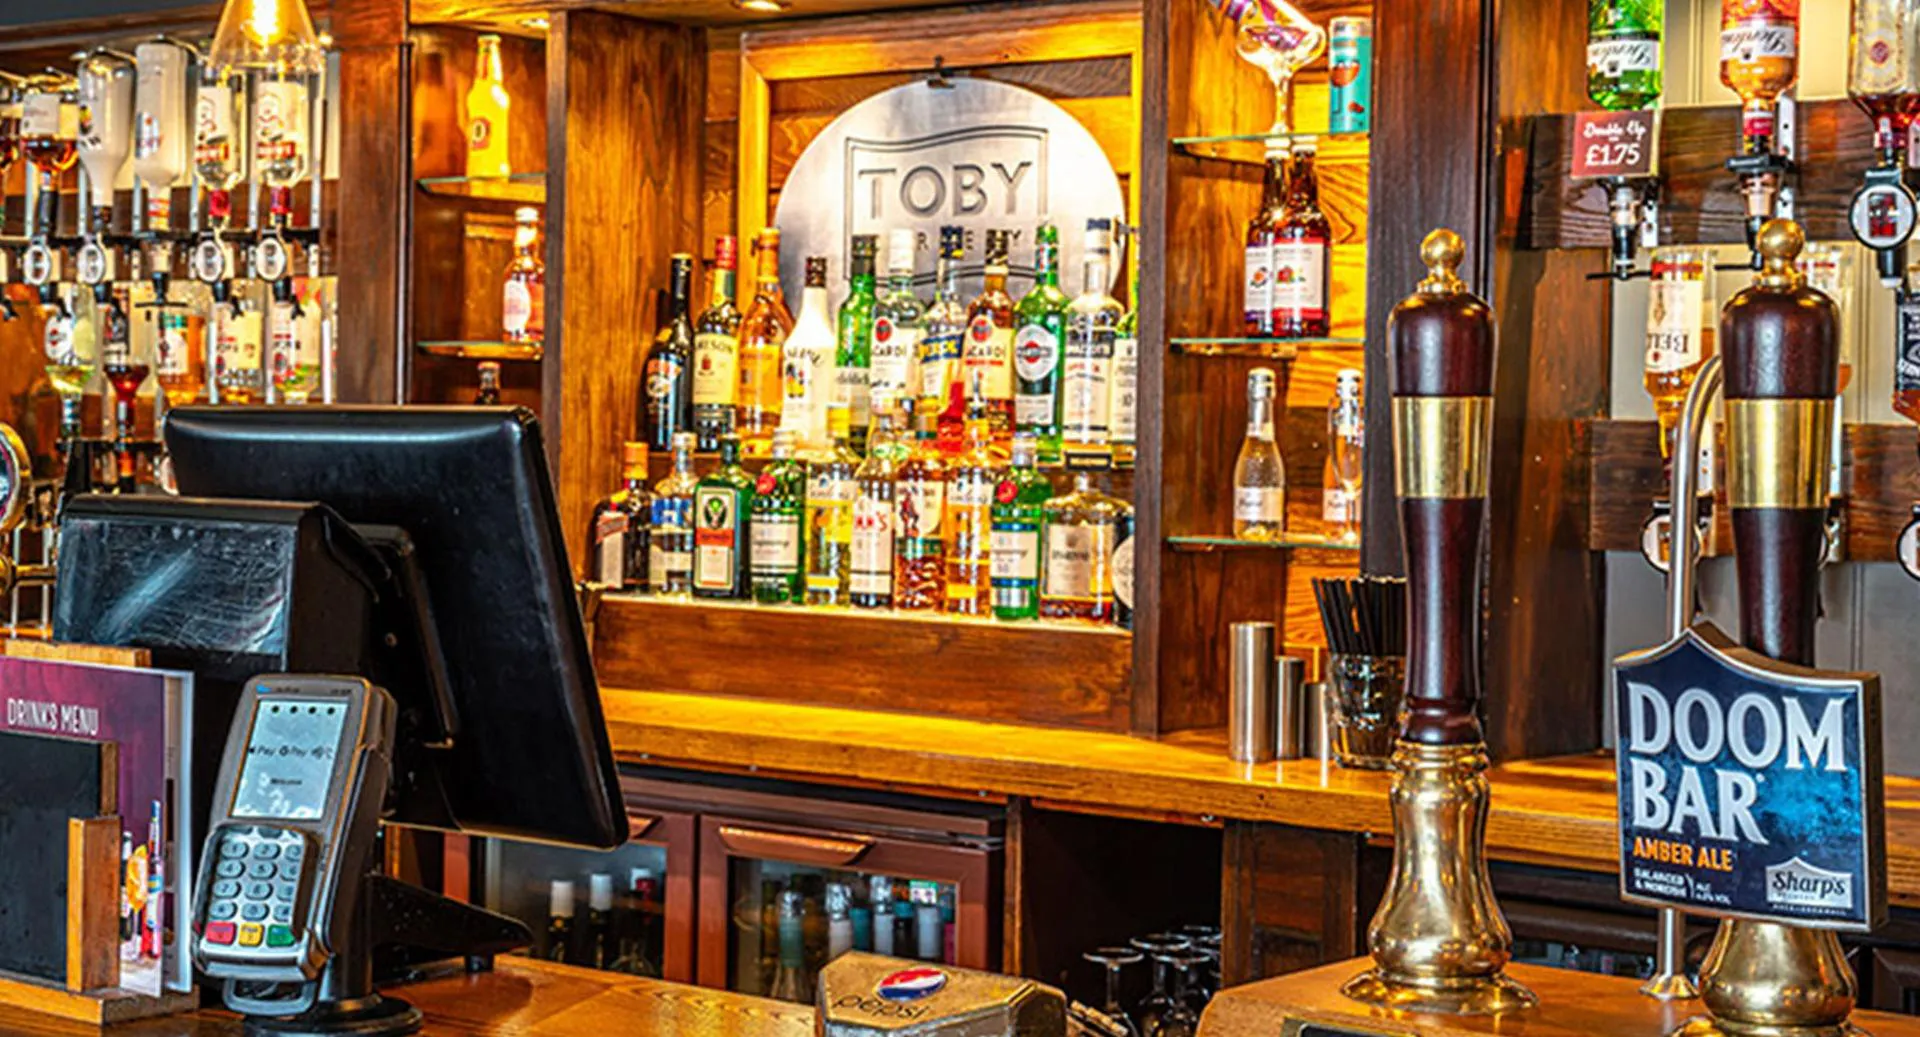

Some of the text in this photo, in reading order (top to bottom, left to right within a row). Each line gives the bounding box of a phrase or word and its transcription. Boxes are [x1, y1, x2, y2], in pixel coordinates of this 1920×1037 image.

[1585, 143, 1640, 165] £1.75
[858, 161, 1033, 219] TOBY
[7, 698, 99, 735] DRINKS MENU
[1627, 682, 1848, 771] DOOM
[1630, 757, 1769, 845] BAR
[1633, 836, 1733, 872] AMBER ALE
[1772, 871, 1845, 898] Sharp's
[831, 994, 930, 1019] pepsi
